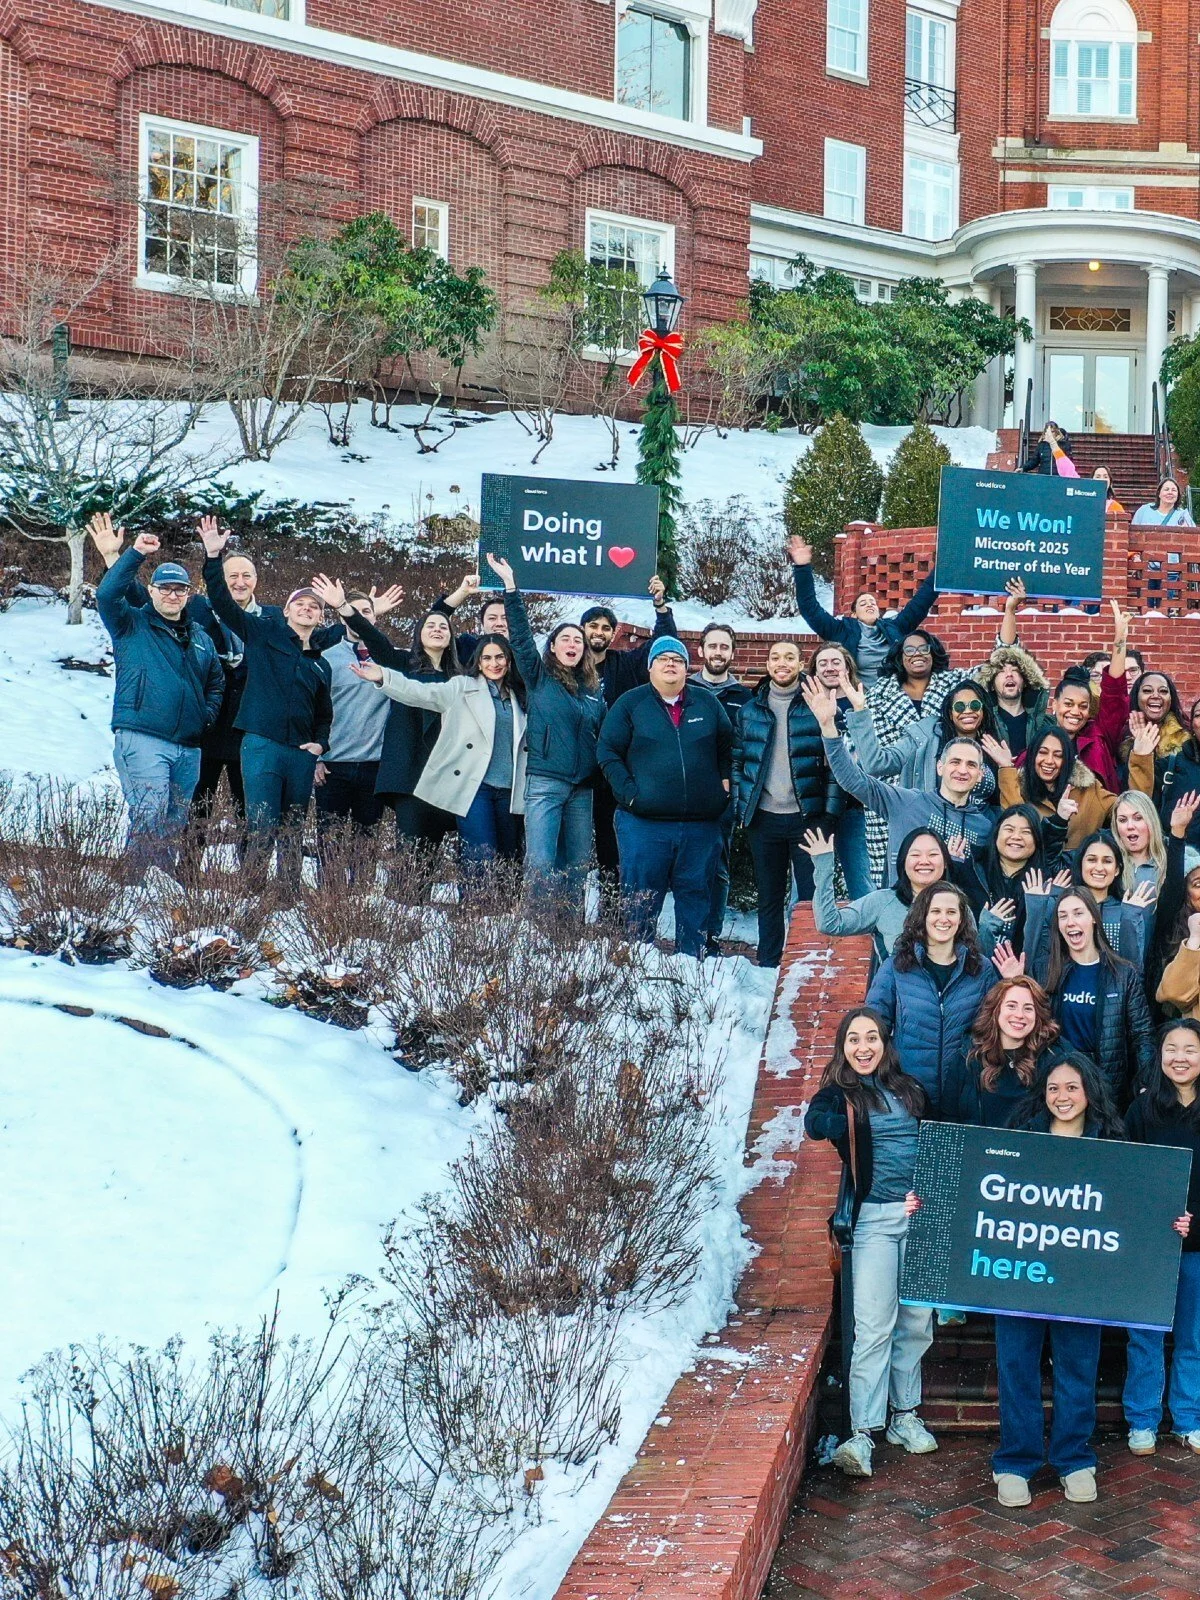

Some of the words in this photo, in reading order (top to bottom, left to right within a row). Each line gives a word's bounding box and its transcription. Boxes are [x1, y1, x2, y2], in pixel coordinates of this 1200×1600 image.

[1074, 489, 1097, 497] Microsoft
[523, 509, 602, 541] Doing
[976, 507, 1011, 530] We
[1017, 511, 1073, 535] Won!
[520, 541, 588, 566] what
[595, 545, 603, 566] I
[974, 536, 1036, 553] Microsoft
[1038, 541, 1069, 555] 2025
[973, 556, 1021, 571] Partner
[1023, 559, 1038, 573] of
[1040, 560, 1061, 574] the
[1063, 562, 1091, 576] Year
[984, 1147, 1021, 1158] cloudforce
[979, 1173, 1103, 1212] Growth
[974, 1211, 1120, 1252] happens
[970, 1248, 1055, 1284] here.
